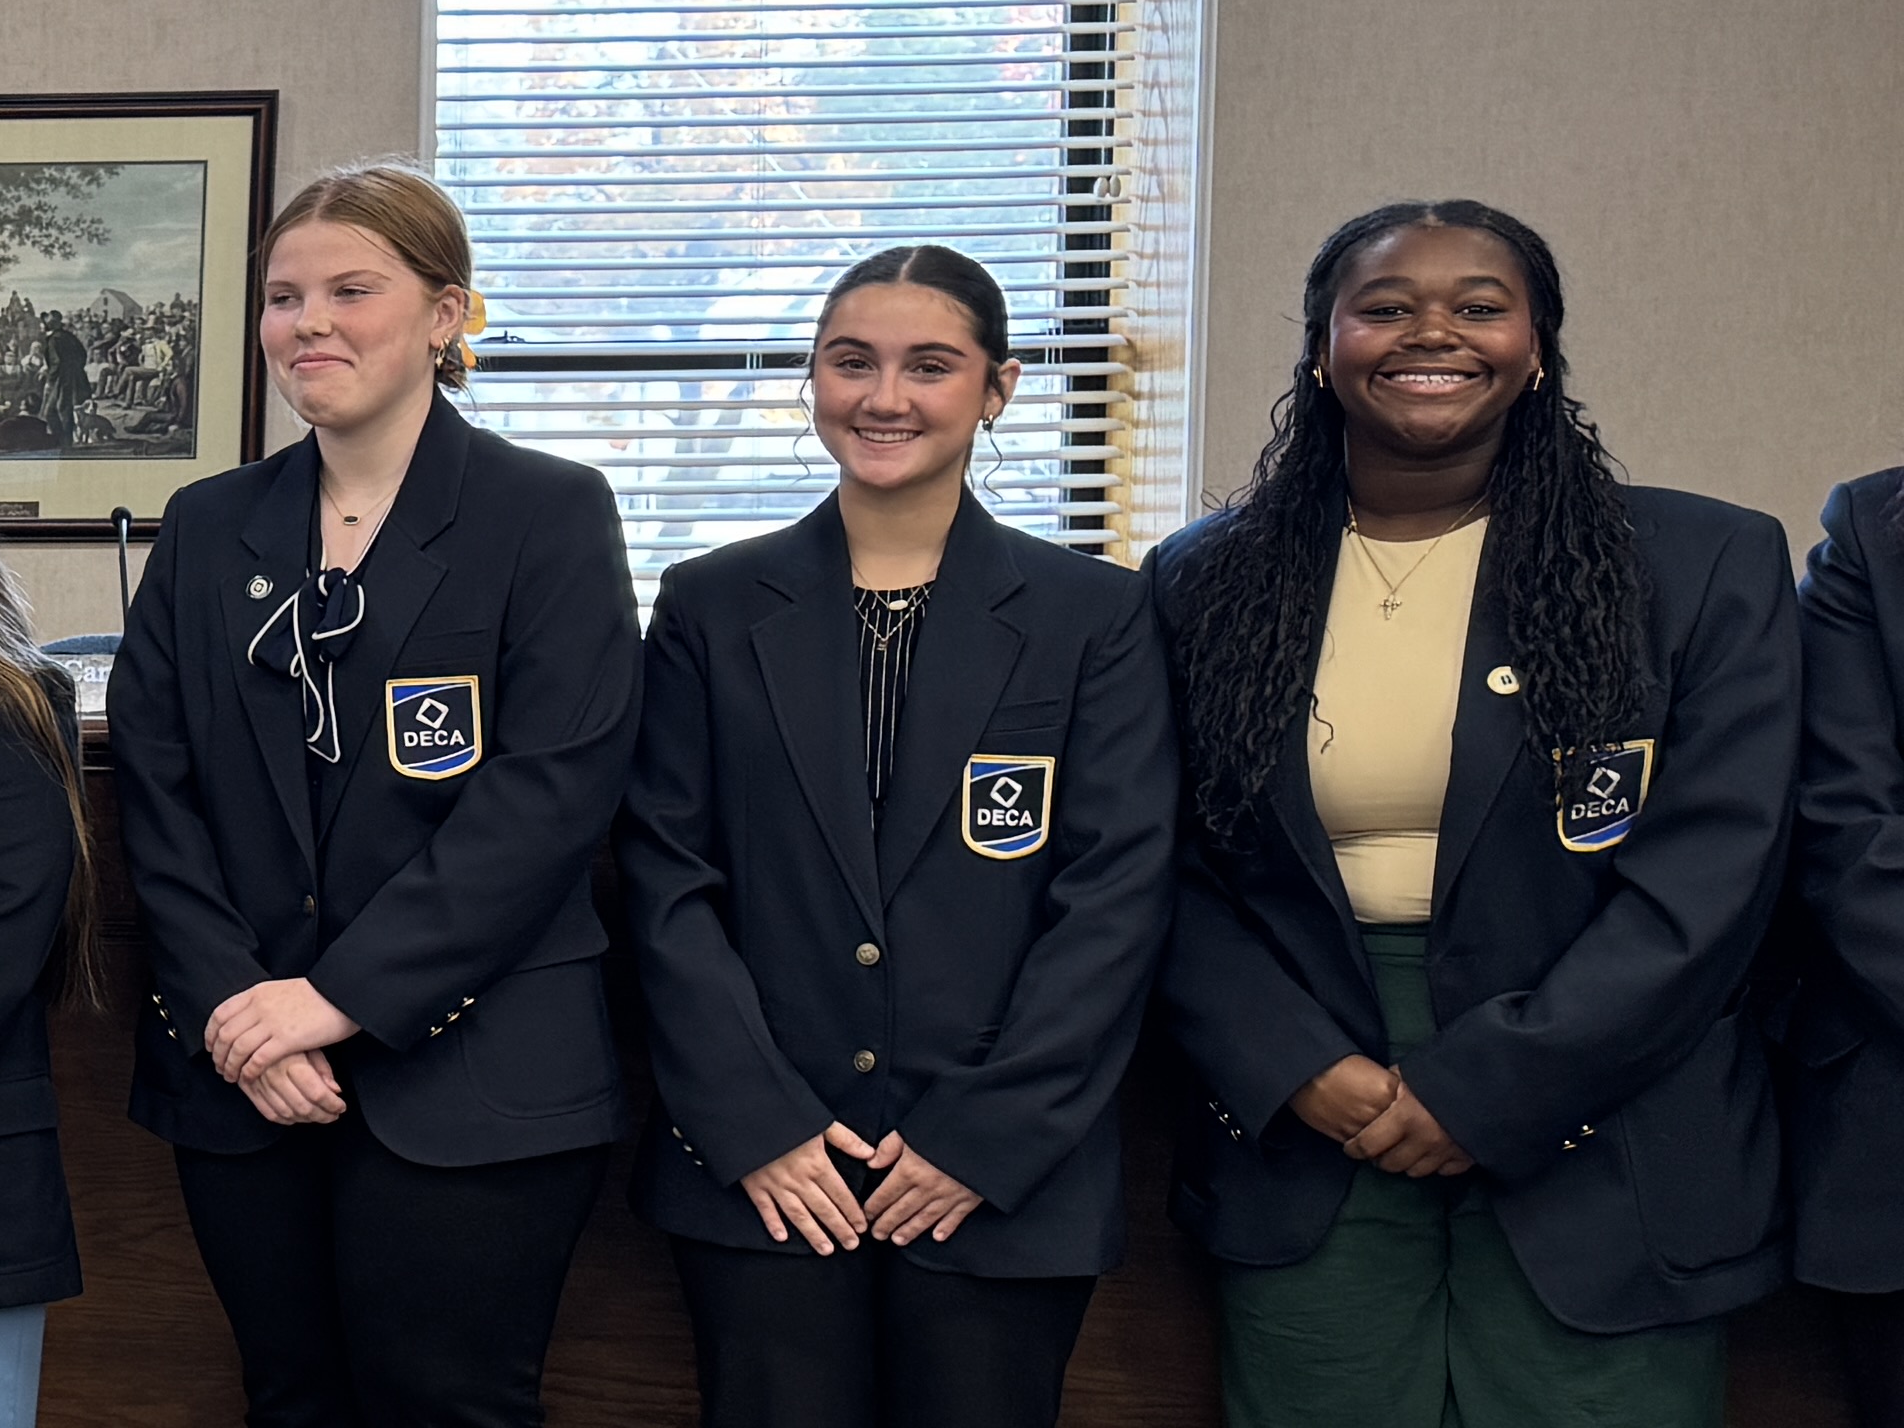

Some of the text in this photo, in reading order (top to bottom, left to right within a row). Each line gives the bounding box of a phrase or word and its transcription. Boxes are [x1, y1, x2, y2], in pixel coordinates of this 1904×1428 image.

[403, 729, 465, 748] DECA
[977, 808, 1033, 827] DECA
[1571, 797, 1630, 820] DECA
